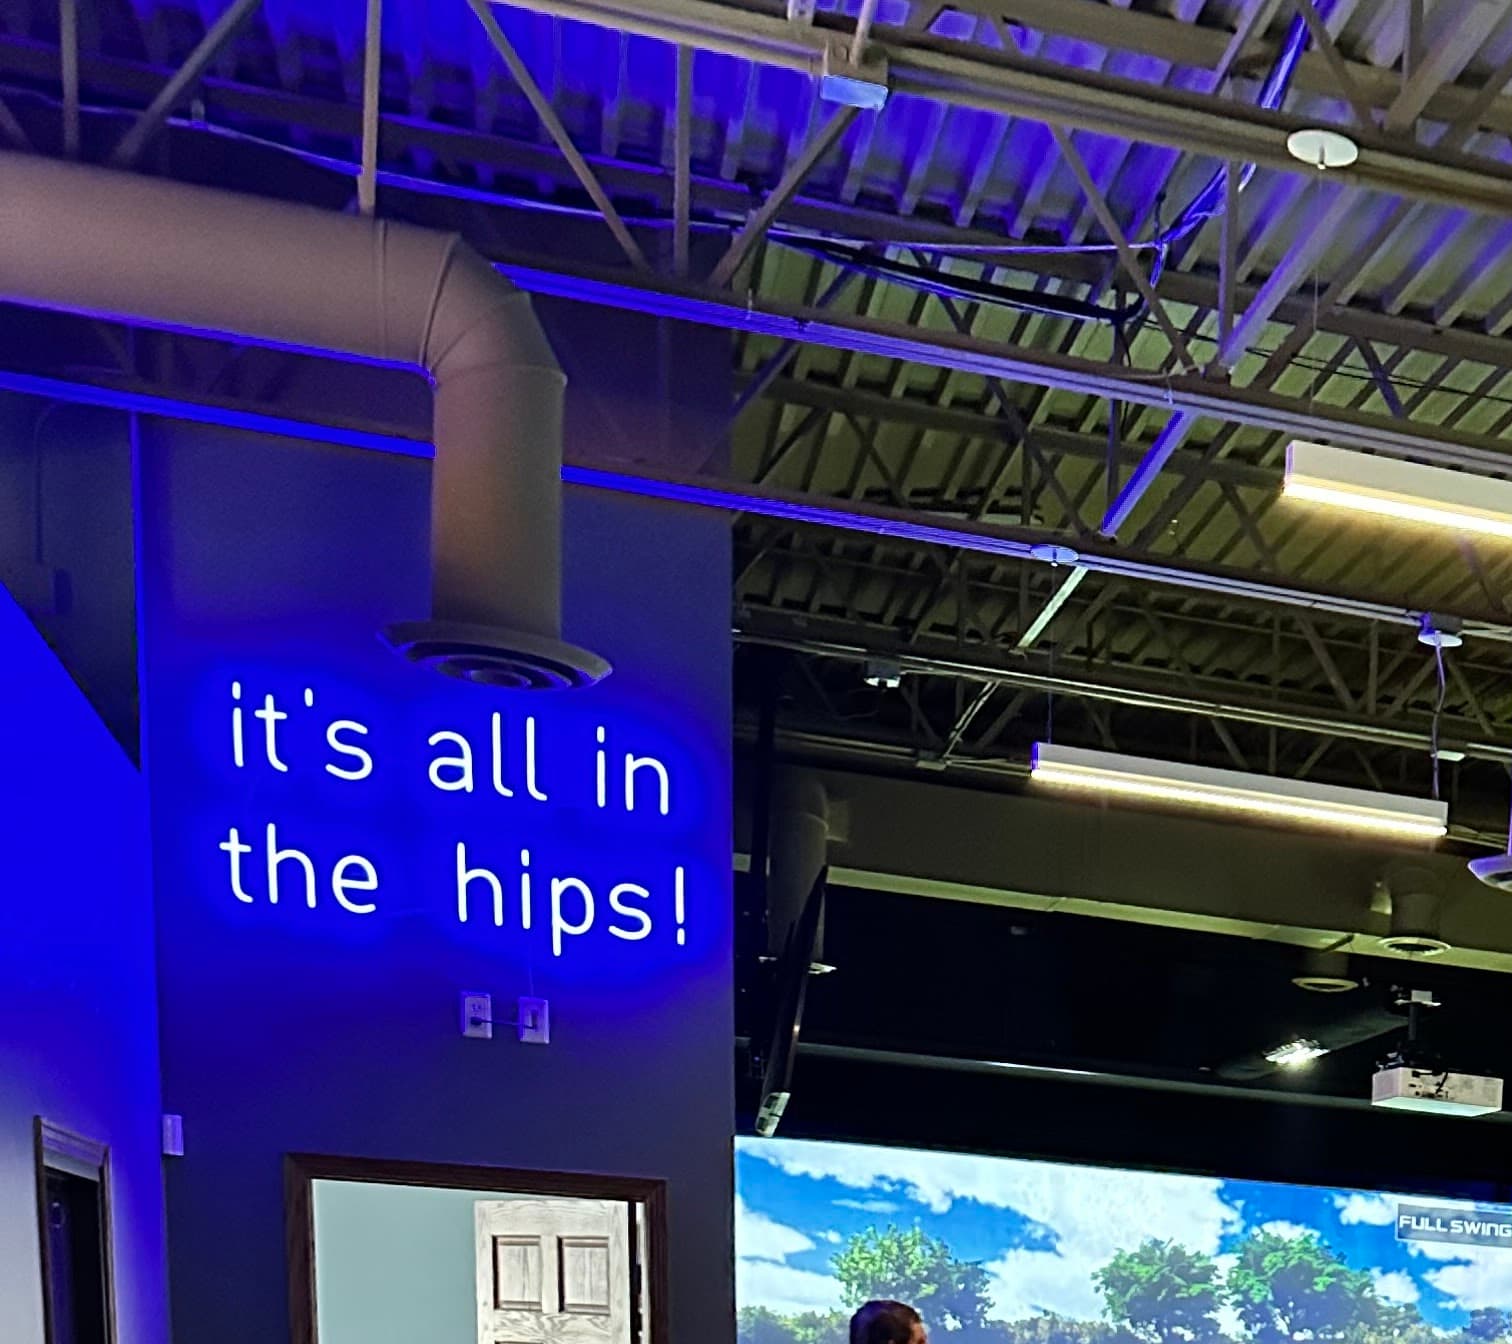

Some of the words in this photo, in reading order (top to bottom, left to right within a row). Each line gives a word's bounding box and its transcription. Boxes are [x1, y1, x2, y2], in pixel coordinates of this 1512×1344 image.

[231, 681, 373, 781] it's
[427, 711, 548, 802] all
[596, 725, 670, 815] in
[219, 822, 379, 914] the
[456, 842, 686, 957] hips!
[1399, 1215, 1448, 1233] FULL
[1450, 1219, 1512, 1238] SWING
